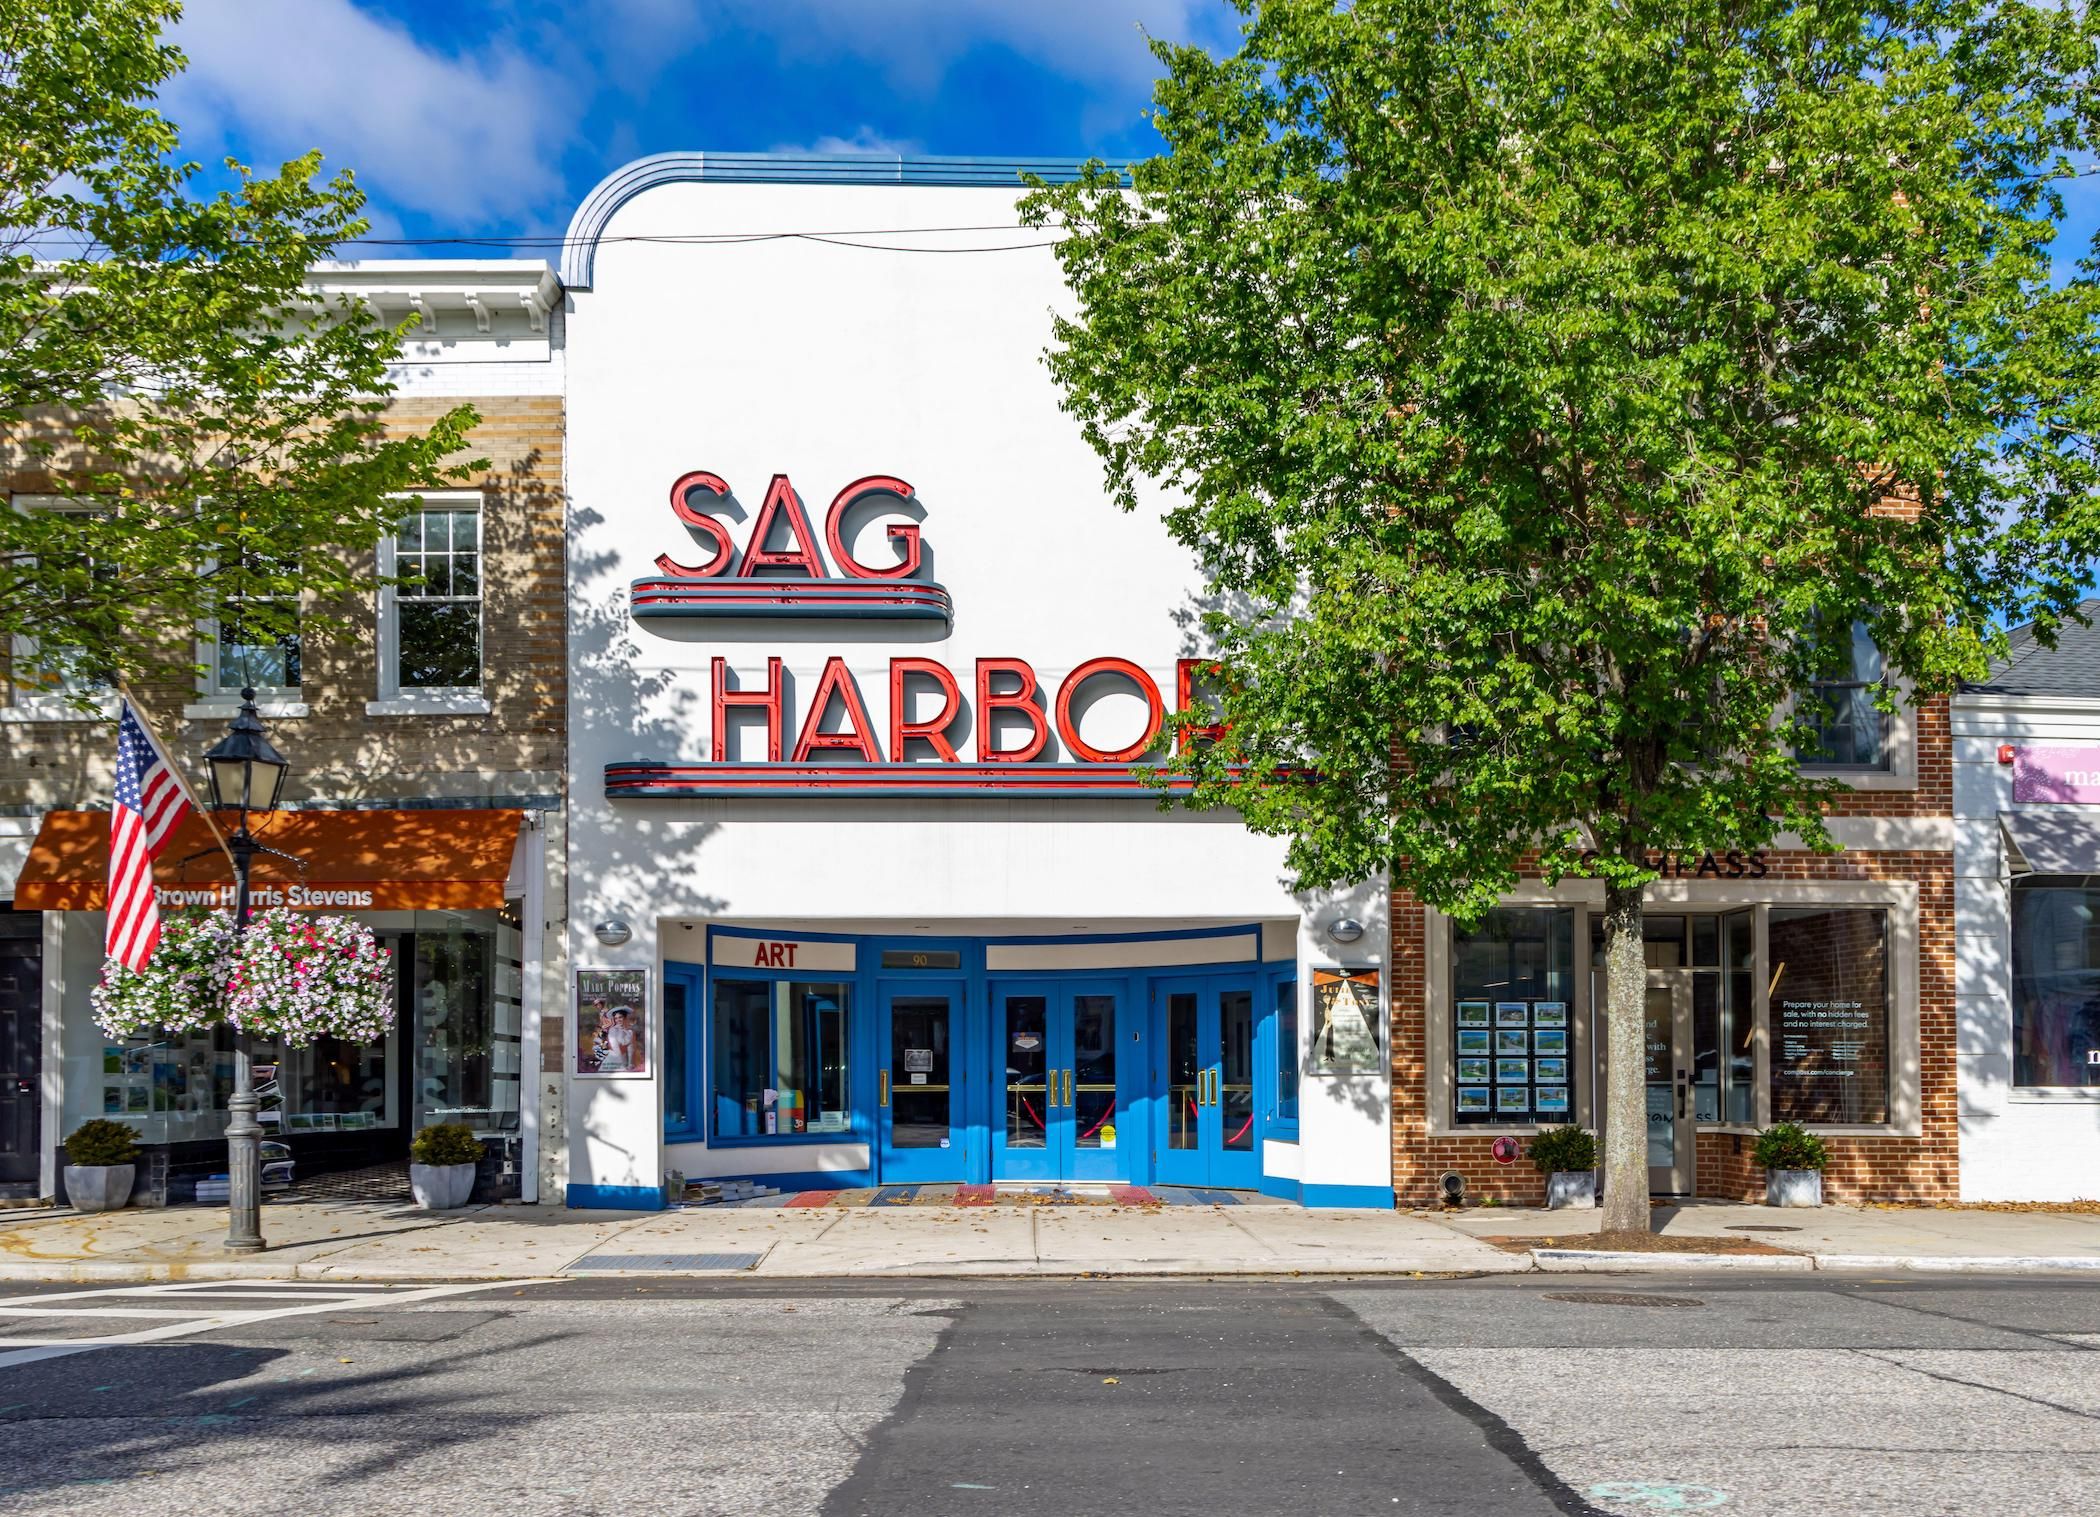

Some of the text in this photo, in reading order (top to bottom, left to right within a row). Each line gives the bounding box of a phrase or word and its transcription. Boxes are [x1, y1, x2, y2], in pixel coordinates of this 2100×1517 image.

[654, 470, 920, 578] SAG
[154, 885, 373, 906] Brown Hrris Stevens
[754, 942, 798, 967] ART
[912, 954, 928, 966] 90
[1783, 1001, 1812, 1009] Prepare
[1853, 1010, 1869, 1018] fees
[1647, 1043, 1666, 1051] with
